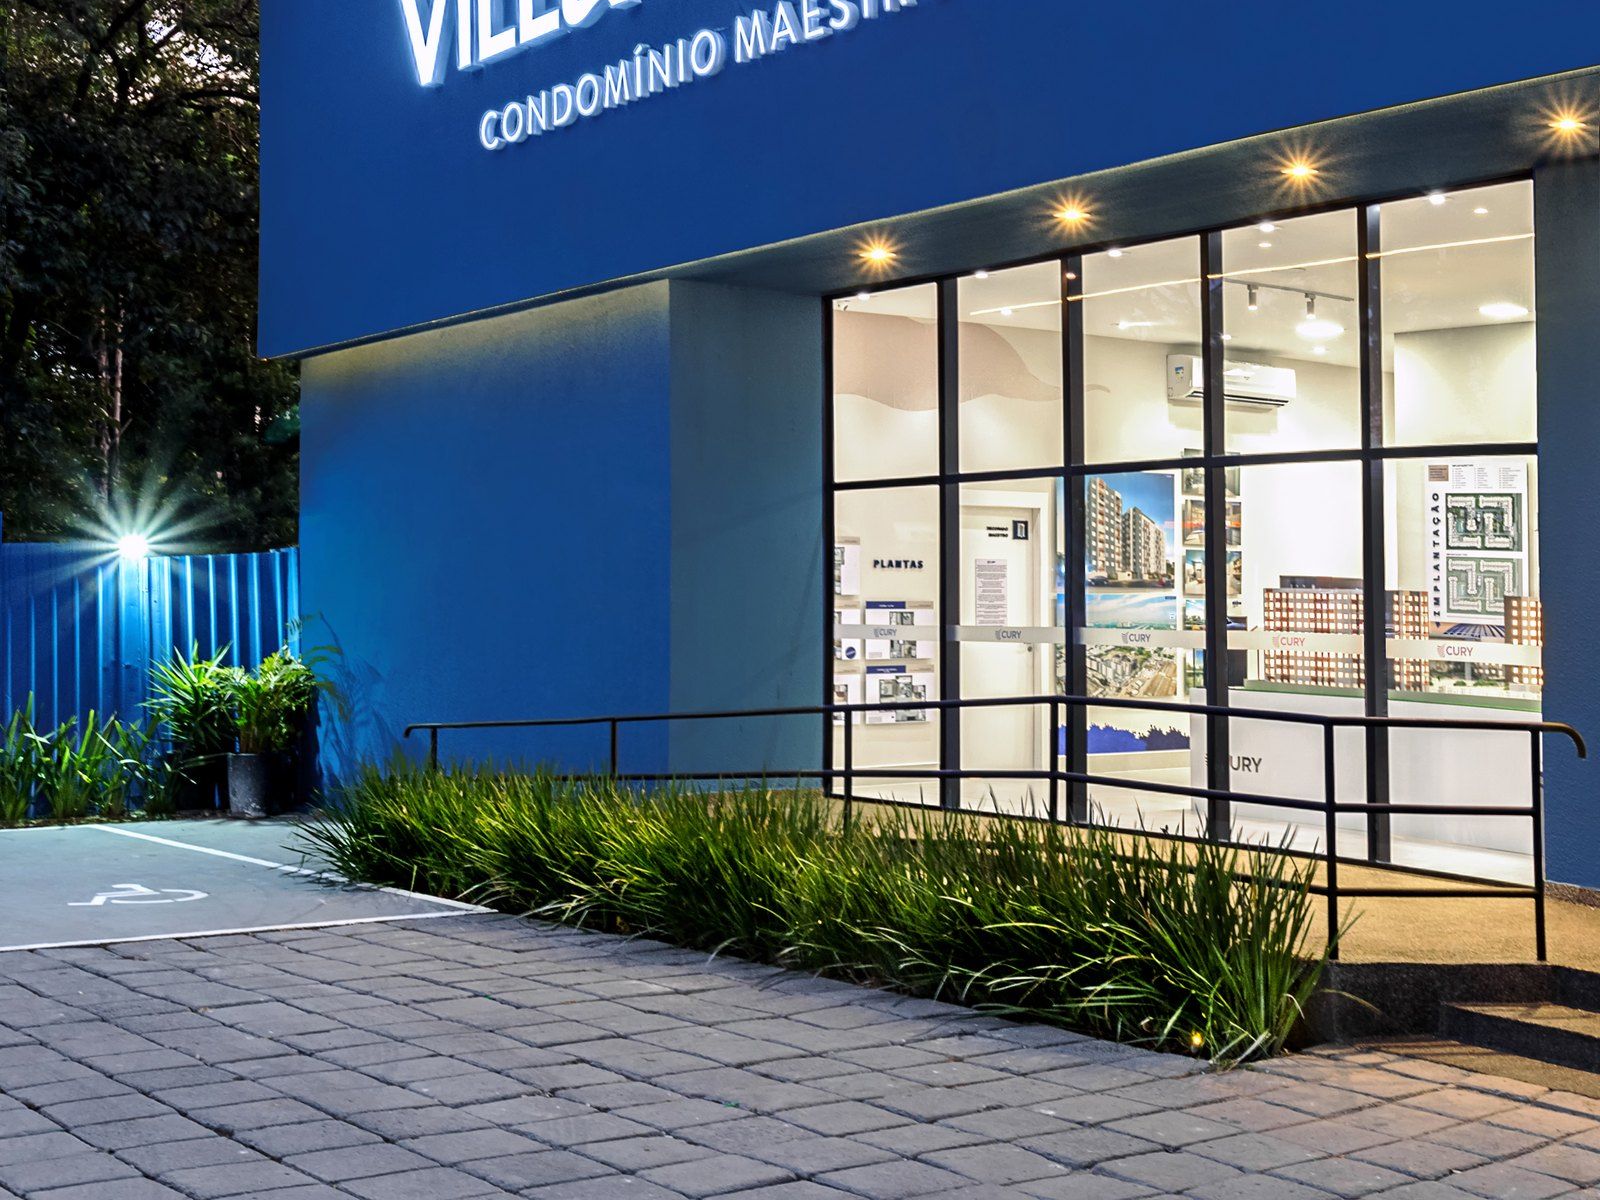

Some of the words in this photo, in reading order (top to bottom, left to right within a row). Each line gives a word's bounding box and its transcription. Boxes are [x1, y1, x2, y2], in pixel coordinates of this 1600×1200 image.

[478, 29, 725, 150] CONDOMÍNIO
[1431, 492, 1441, 617] IMPLANTAÇÃO
[873, 559, 924, 569] PLANTAS
[880, 628, 897, 637] CURY
[1001, 630, 1022, 639] CURY
[1129, 633, 1151, 643] CURY
[1280, 636, 1305, 647] CURY
[1446, 645, 1473, 657] CURY
[1229, 756, 1262, 773] URY
